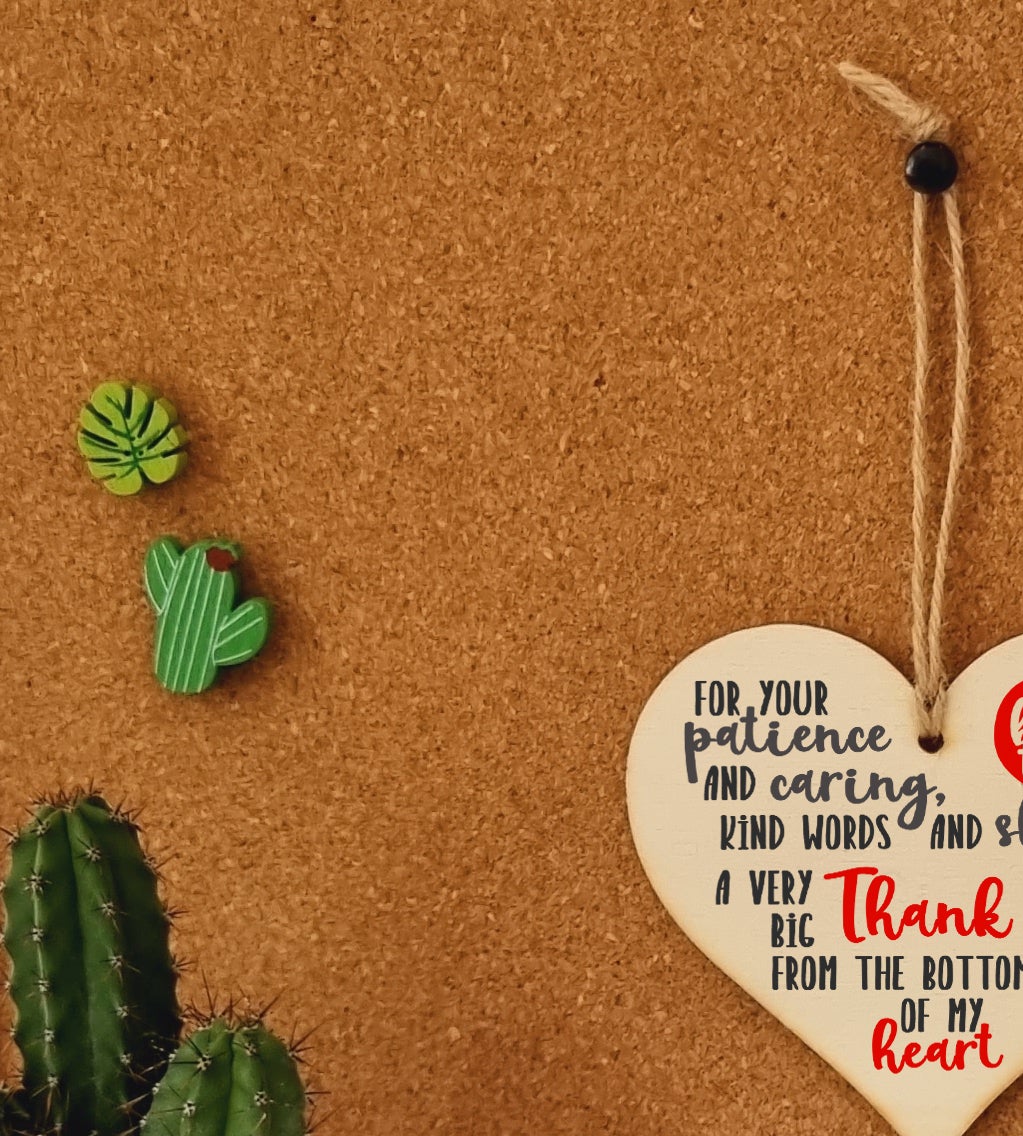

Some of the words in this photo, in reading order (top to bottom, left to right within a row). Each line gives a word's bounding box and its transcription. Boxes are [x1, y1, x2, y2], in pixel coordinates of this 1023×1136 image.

[695, 680, 740, 717] FOR
[760, 680, 828, 717] YOUR
[685, 706, 892, 784] patience
[704, 765, 756, 801] AND
[771, 768, 946, 831] caring,
[803, 814, 892, 851] WORDS
[930, 813, 983, 851] AND
[715, 869, 731, 906] A
[749, 869, 813, 906] VERY
[823, 866, 1014, 944] Thank
[771, 955, 837, 991] FROM
[855, 955, 905, 991] THE
[900, 997, 930, 1034] OF
[948, 997, 984, 1034] MY
[871, 1017, 1004, 1075] heart
